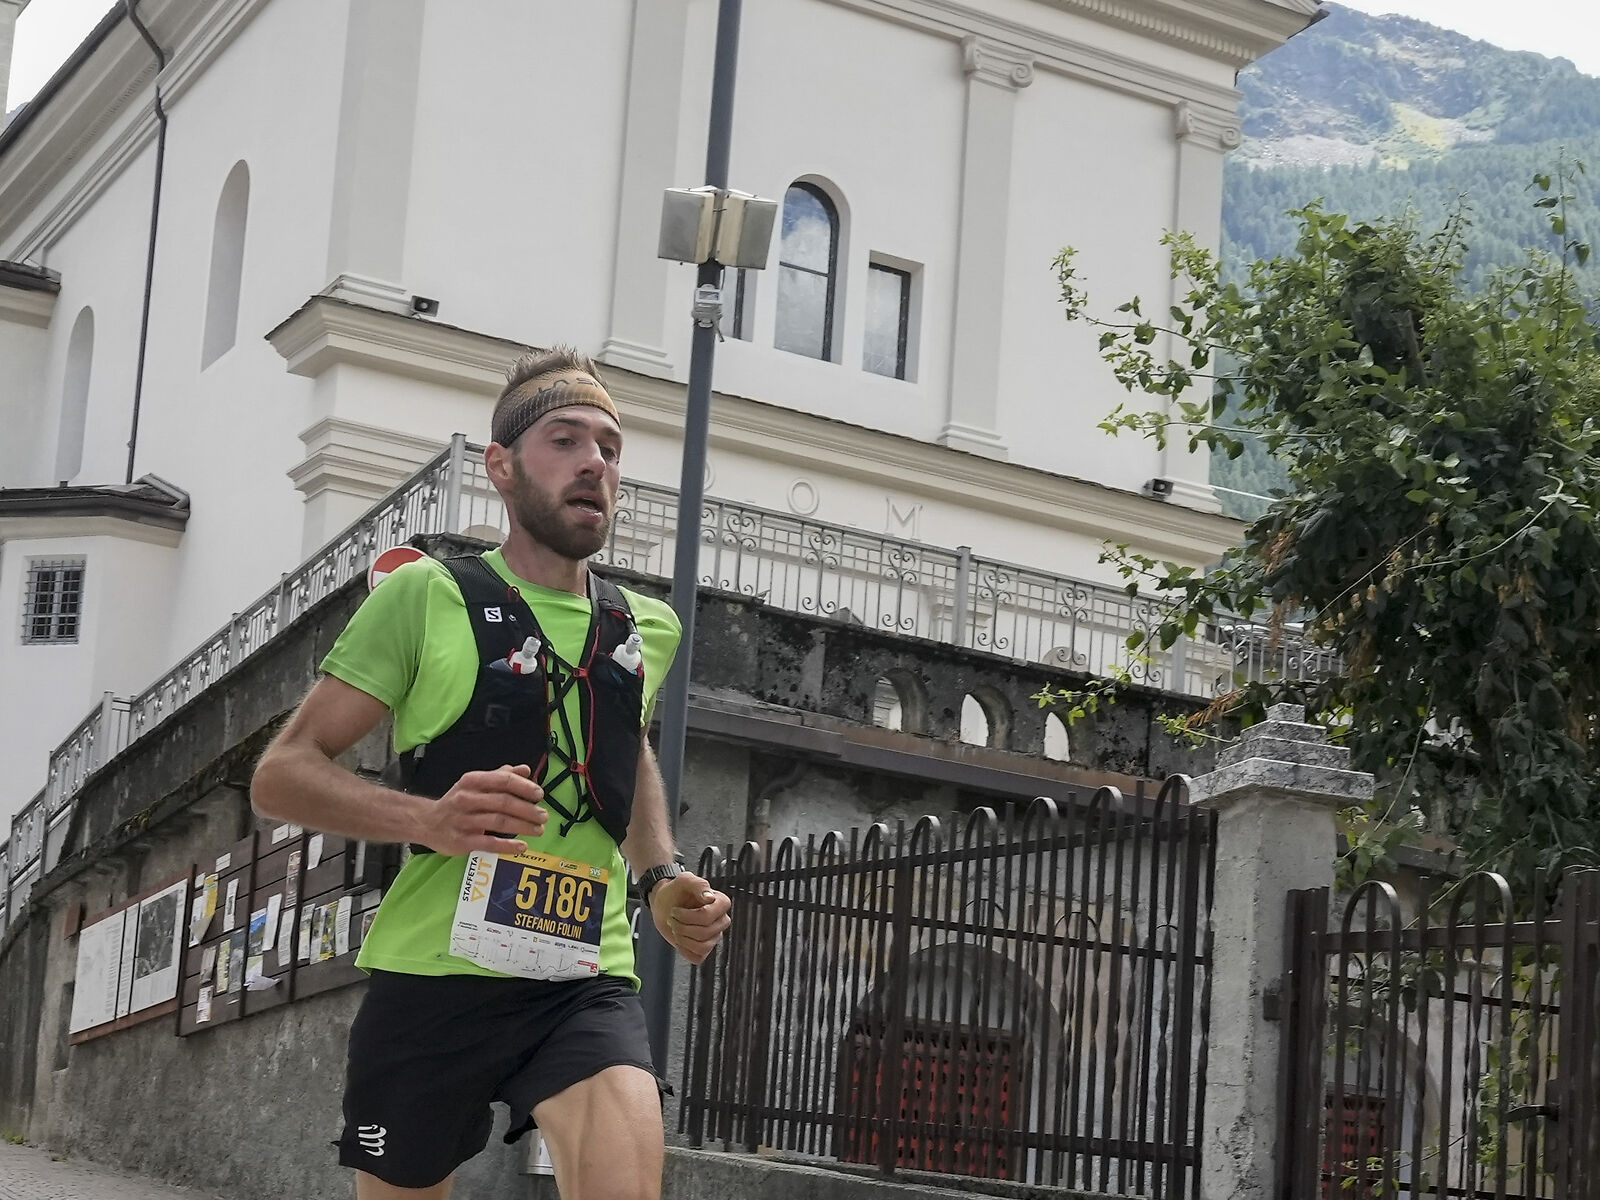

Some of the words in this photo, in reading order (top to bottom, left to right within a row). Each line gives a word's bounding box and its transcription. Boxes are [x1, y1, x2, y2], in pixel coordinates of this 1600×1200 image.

[462, 856, 479, 902] STAFFETTA
[515, 866, 593, 923] 518C
[514, 912, 556, 934] STEFANO
[556, 922, 583, 940] FOLINI
